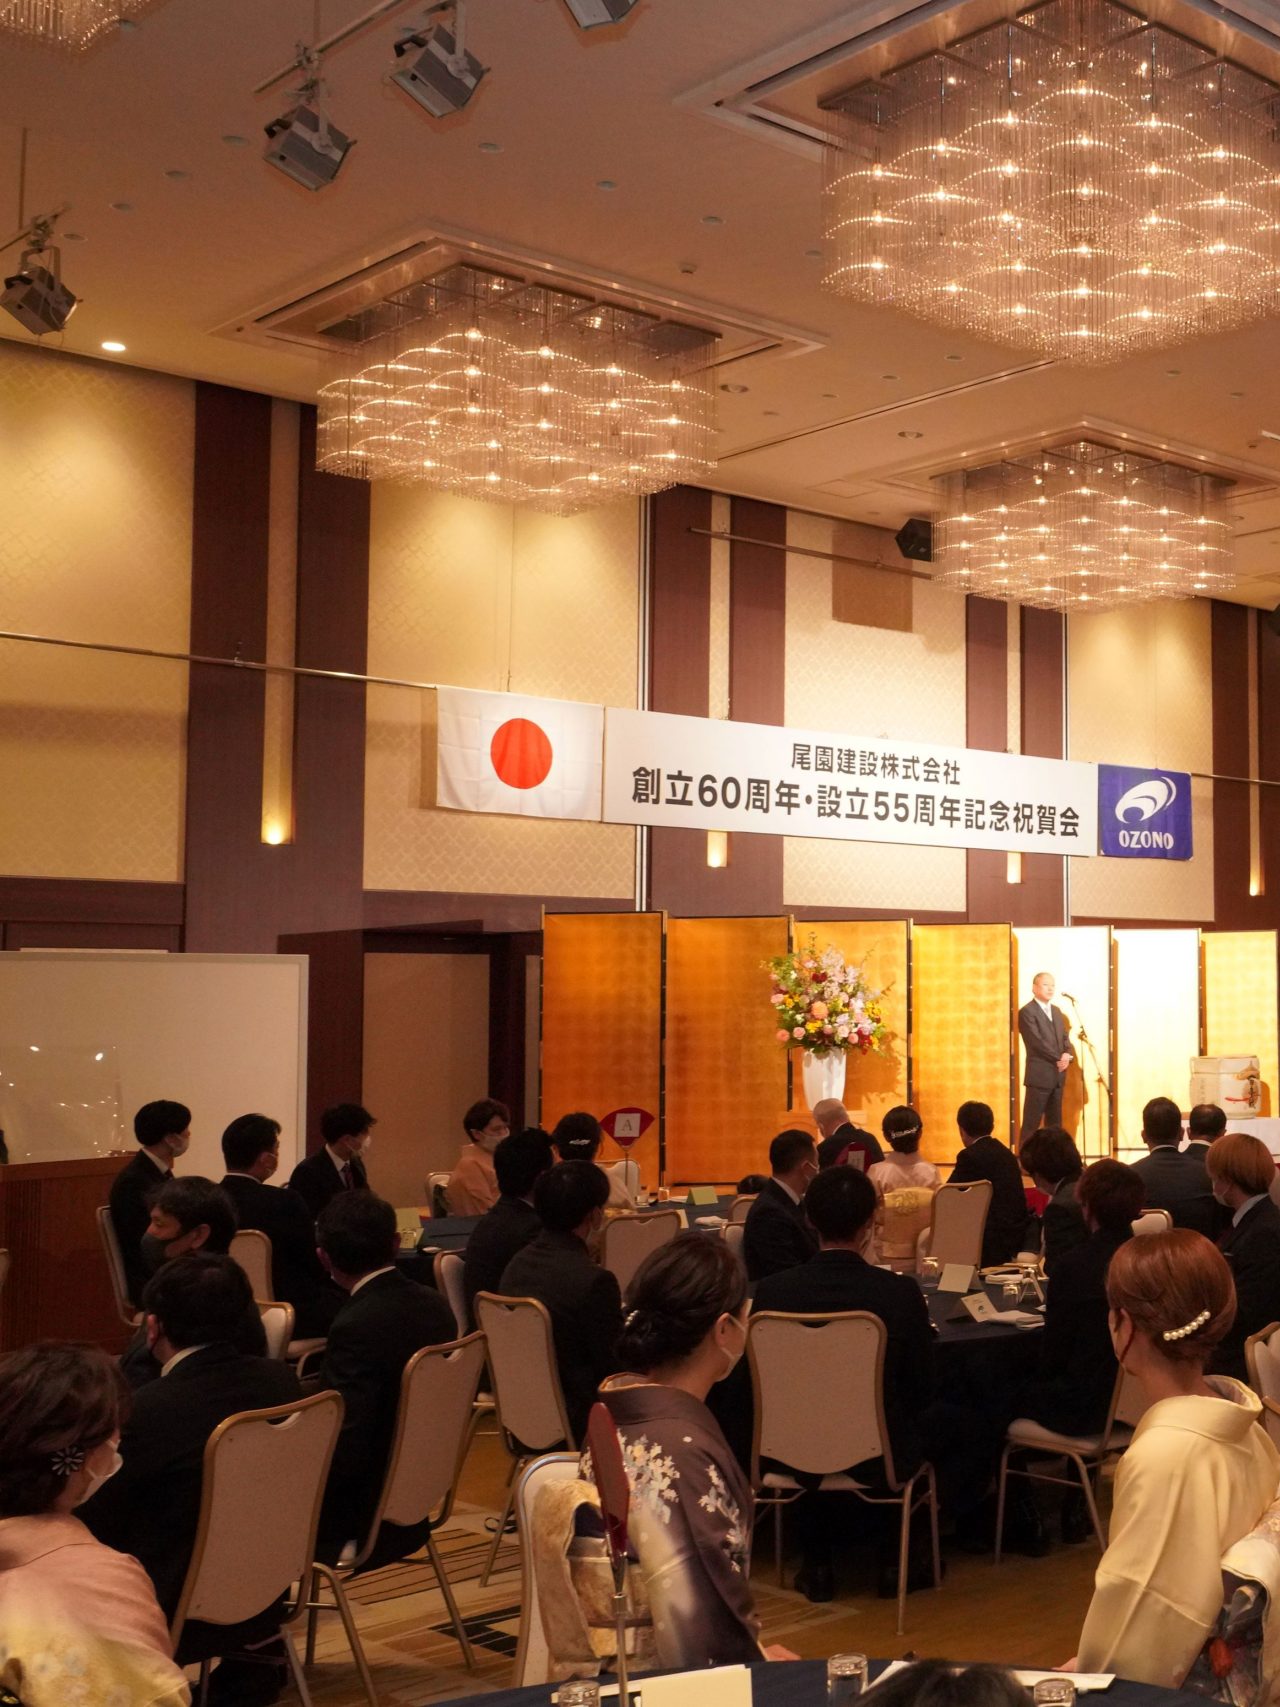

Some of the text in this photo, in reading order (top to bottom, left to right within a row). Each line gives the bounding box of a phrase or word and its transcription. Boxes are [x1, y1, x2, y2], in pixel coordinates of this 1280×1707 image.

[792, 743, 961, 786] 尾園建設株式会社
[632, 766, 1080, 838] 創立60周年・設立55周年記念祝賀会
[1118, 830, 1175, 850] OZONO
[621, 1119, 633, 1131] A
